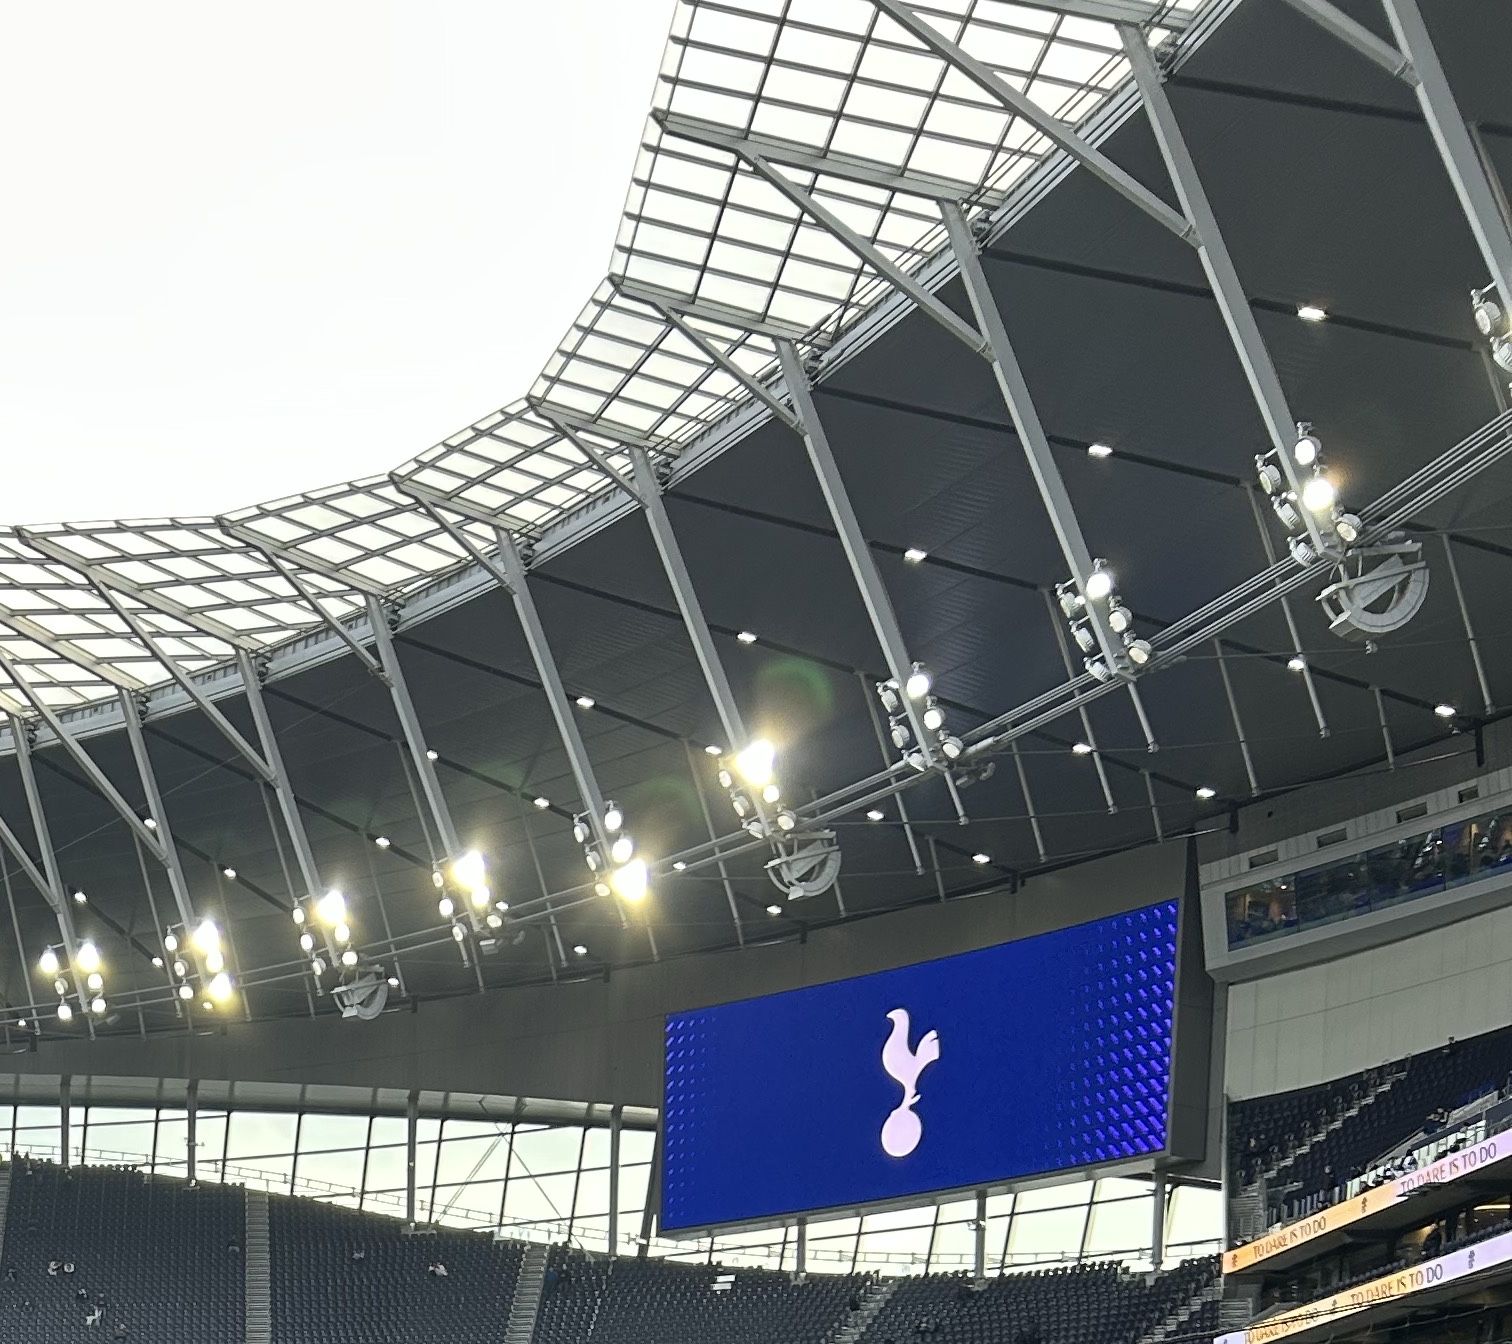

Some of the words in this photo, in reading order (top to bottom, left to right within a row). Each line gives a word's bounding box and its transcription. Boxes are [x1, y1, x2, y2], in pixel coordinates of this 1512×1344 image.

[1400, 1178, 1414, 1193] TO
[1417, 1165, 1446, 1187] DARE
[1449, 1159, 1460, 1176] IS
[1462, 1150, 1477, 1169] TO
[1480, 1142, 1497, 1164] DO
[1253, 1243, 1265, 1259] TO
[1266, 1232, 1287, 1255] DARE
[1288, 1229, 1299, 1244] IS
[1299, 1221, 1312, 1239] TO
[1313, 1215, 1327, 1231] DO
[1350, 1291, 1365, 1307] TO
[1366, 1280, 1393, 1302] DARE
[1397, 1278, 1407, 1293] IS
[1409, 1270, 1424, 1288] TO
[1426, 1263, 1443, 1281] DO
[1244, 1330, 1256, 1344] TO
